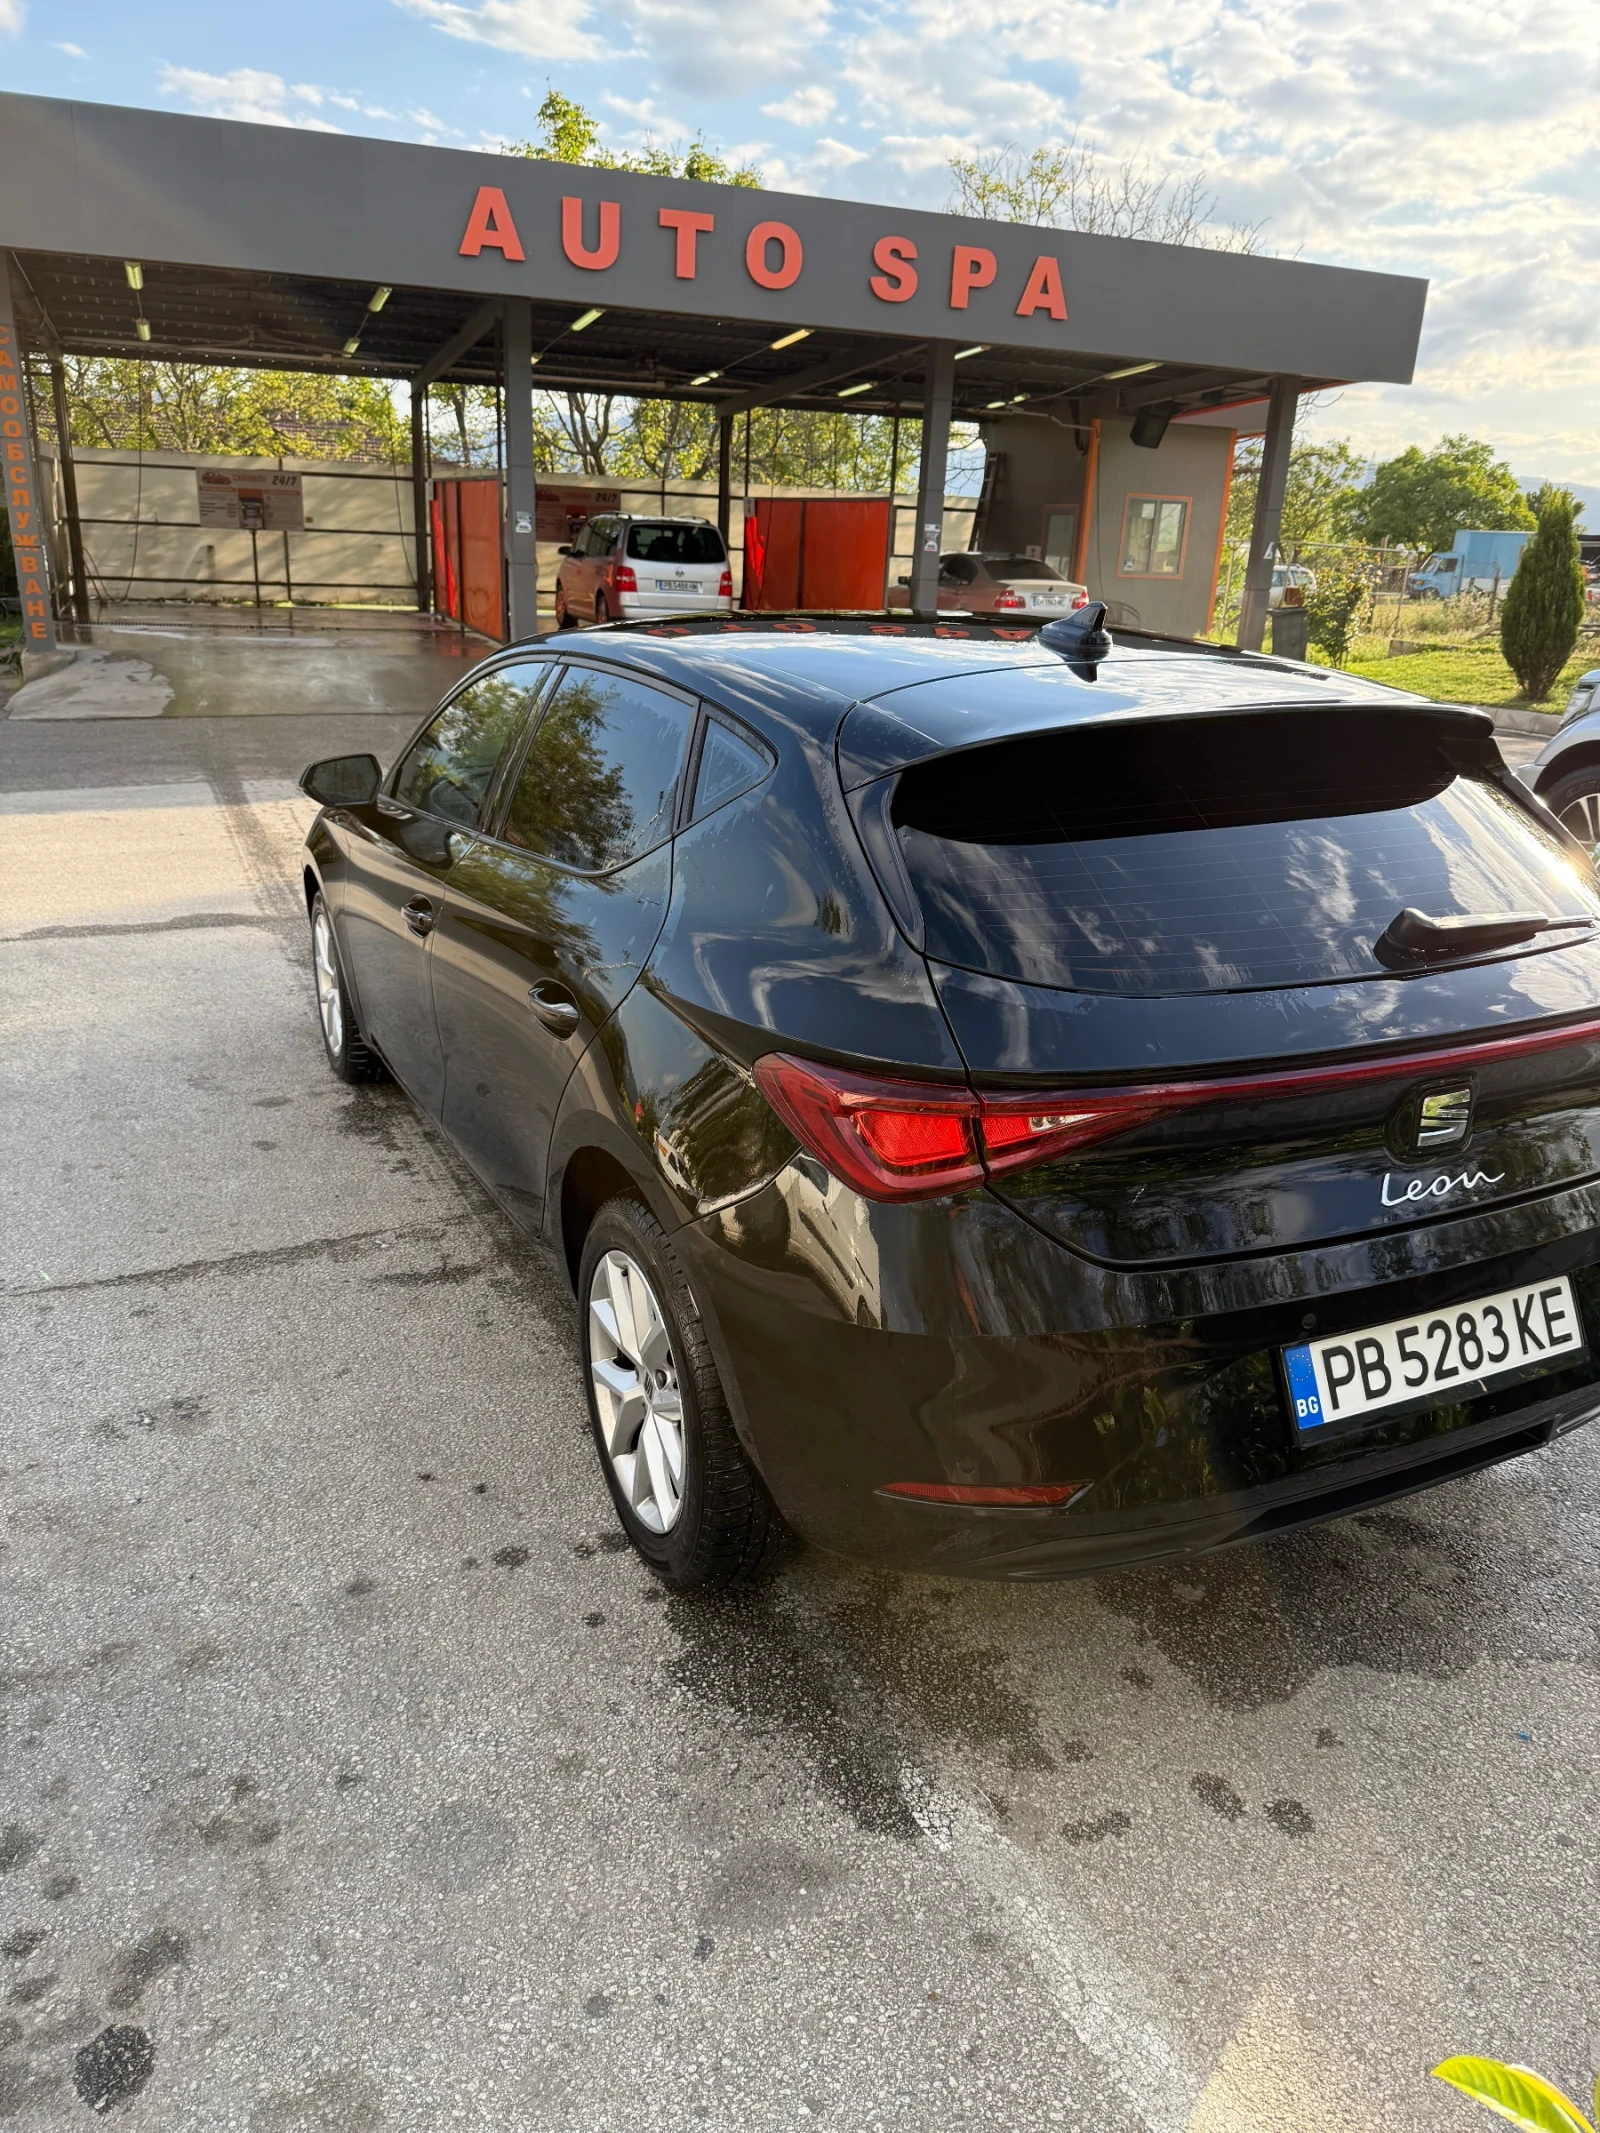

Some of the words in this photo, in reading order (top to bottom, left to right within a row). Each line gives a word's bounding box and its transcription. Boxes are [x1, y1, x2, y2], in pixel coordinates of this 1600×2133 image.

[459, 186, 803, 290] AUTO
[870, 236, 1069, 320] SPA
[272, 475, 298, 486] 24/7
[595, 492, 618, 503] 24/7
[1380, 1171, 1506, 1207] Leon
[1296, 1396, 1319, 1418] BG
